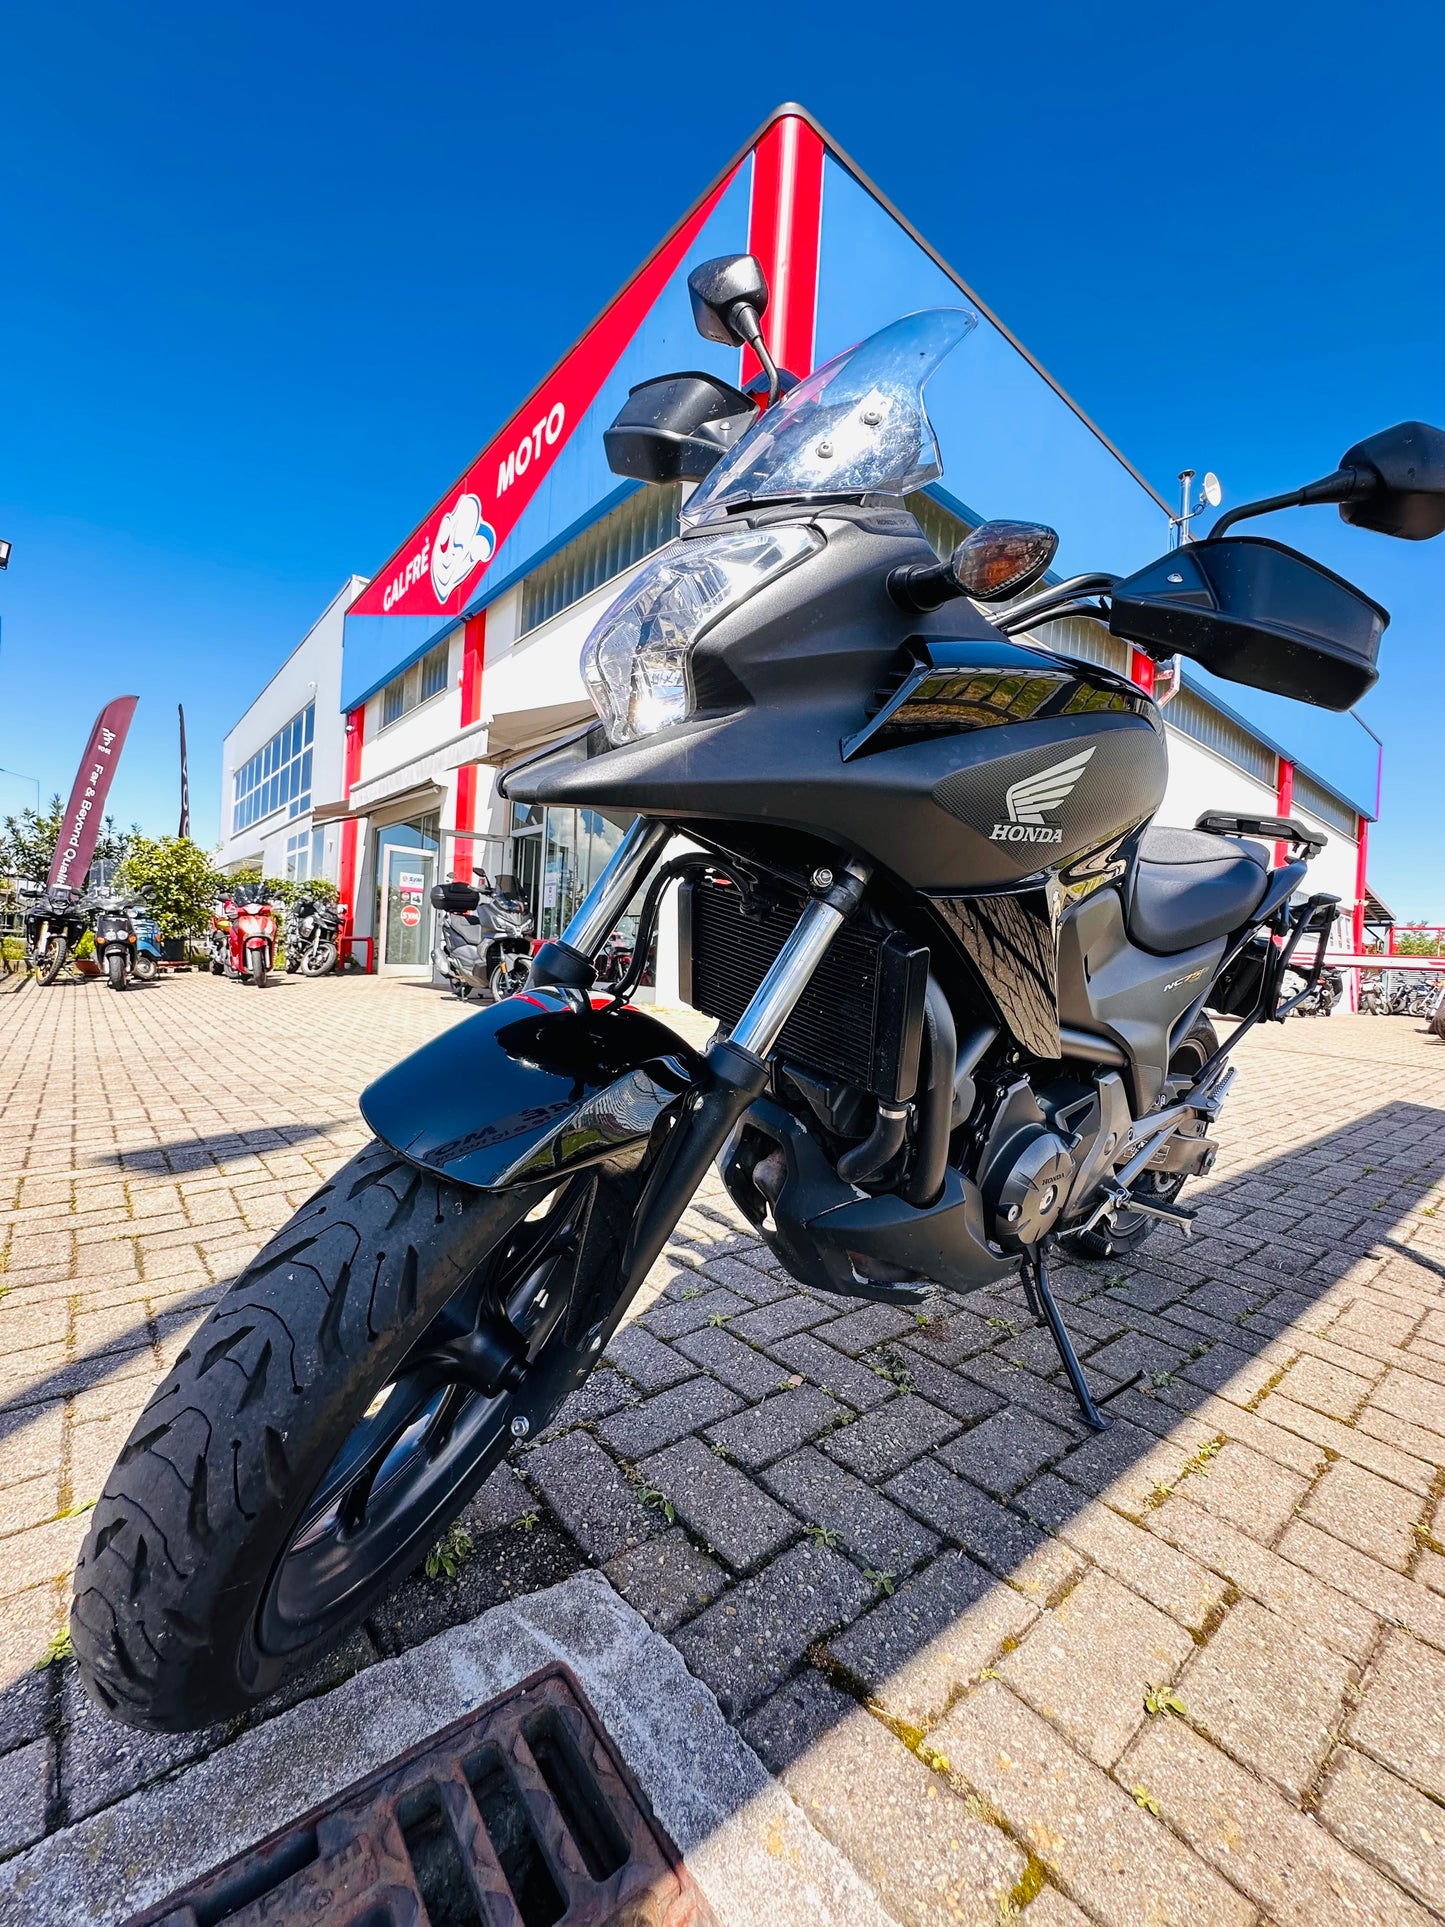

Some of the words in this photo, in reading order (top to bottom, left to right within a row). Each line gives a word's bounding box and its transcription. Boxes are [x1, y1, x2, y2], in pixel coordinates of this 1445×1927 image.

[496, 402, 565, 499] MOTO
[90, 763, 104, 785] Far
[84, 787, 95, 797] &
[69, 800, 92, 847] Beyond
[988, 824, 1063, 844] HONDA
[57, 848, 76, 885] Qualit
[1041, 1173, 1065, 1186] HONDA
